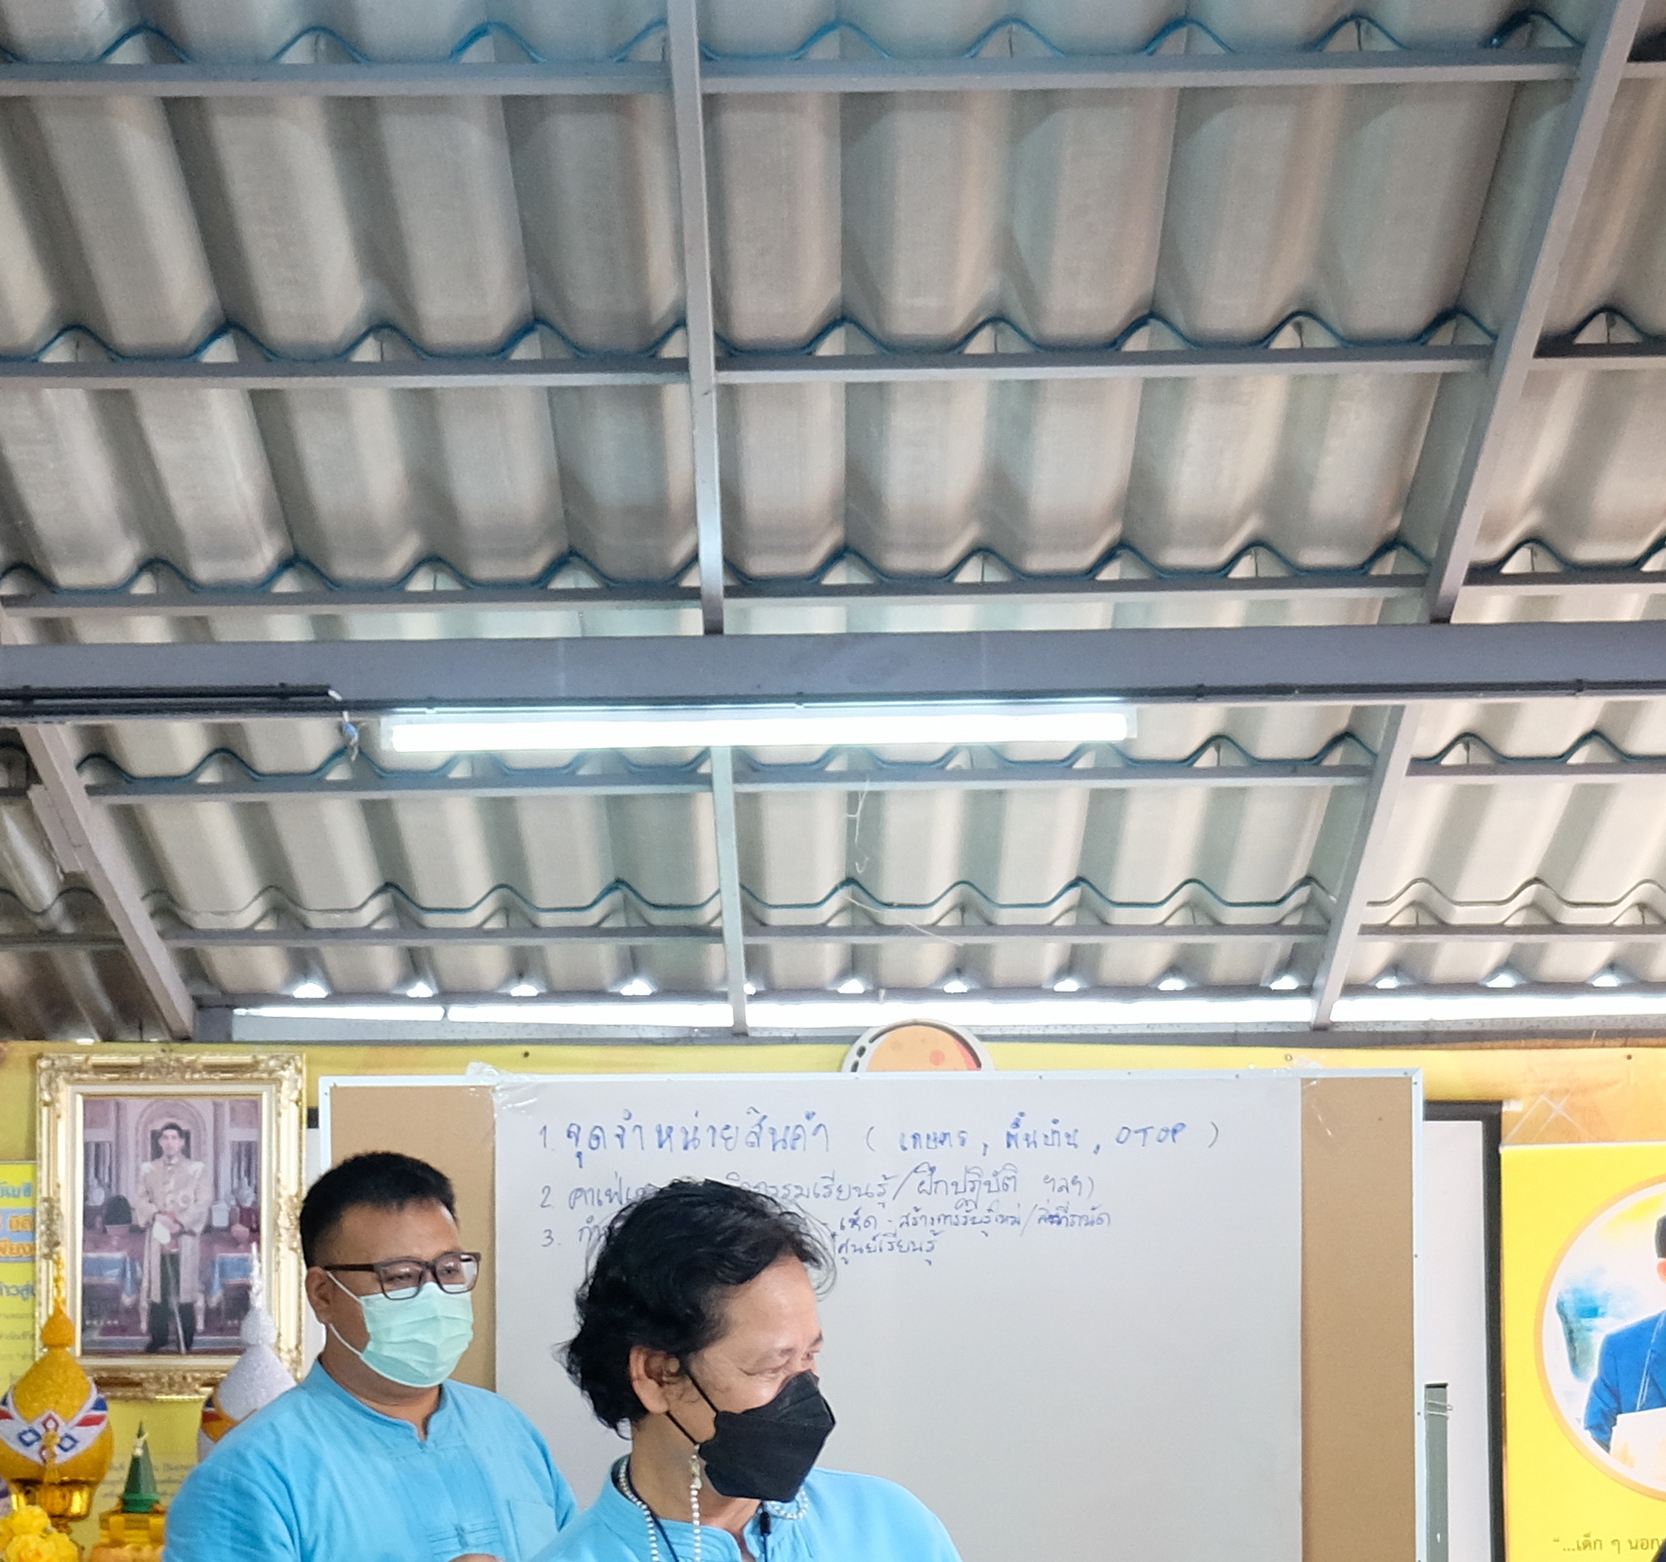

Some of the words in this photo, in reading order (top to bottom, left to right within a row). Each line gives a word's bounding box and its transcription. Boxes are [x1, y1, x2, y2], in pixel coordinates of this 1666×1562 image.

[566, 1106, 830, 1169] จุดจำหน่ายสินค้า
[1115, 1121, 1188, 1148] OTOP
[1627, 1537, 1662, 1551] นอก
